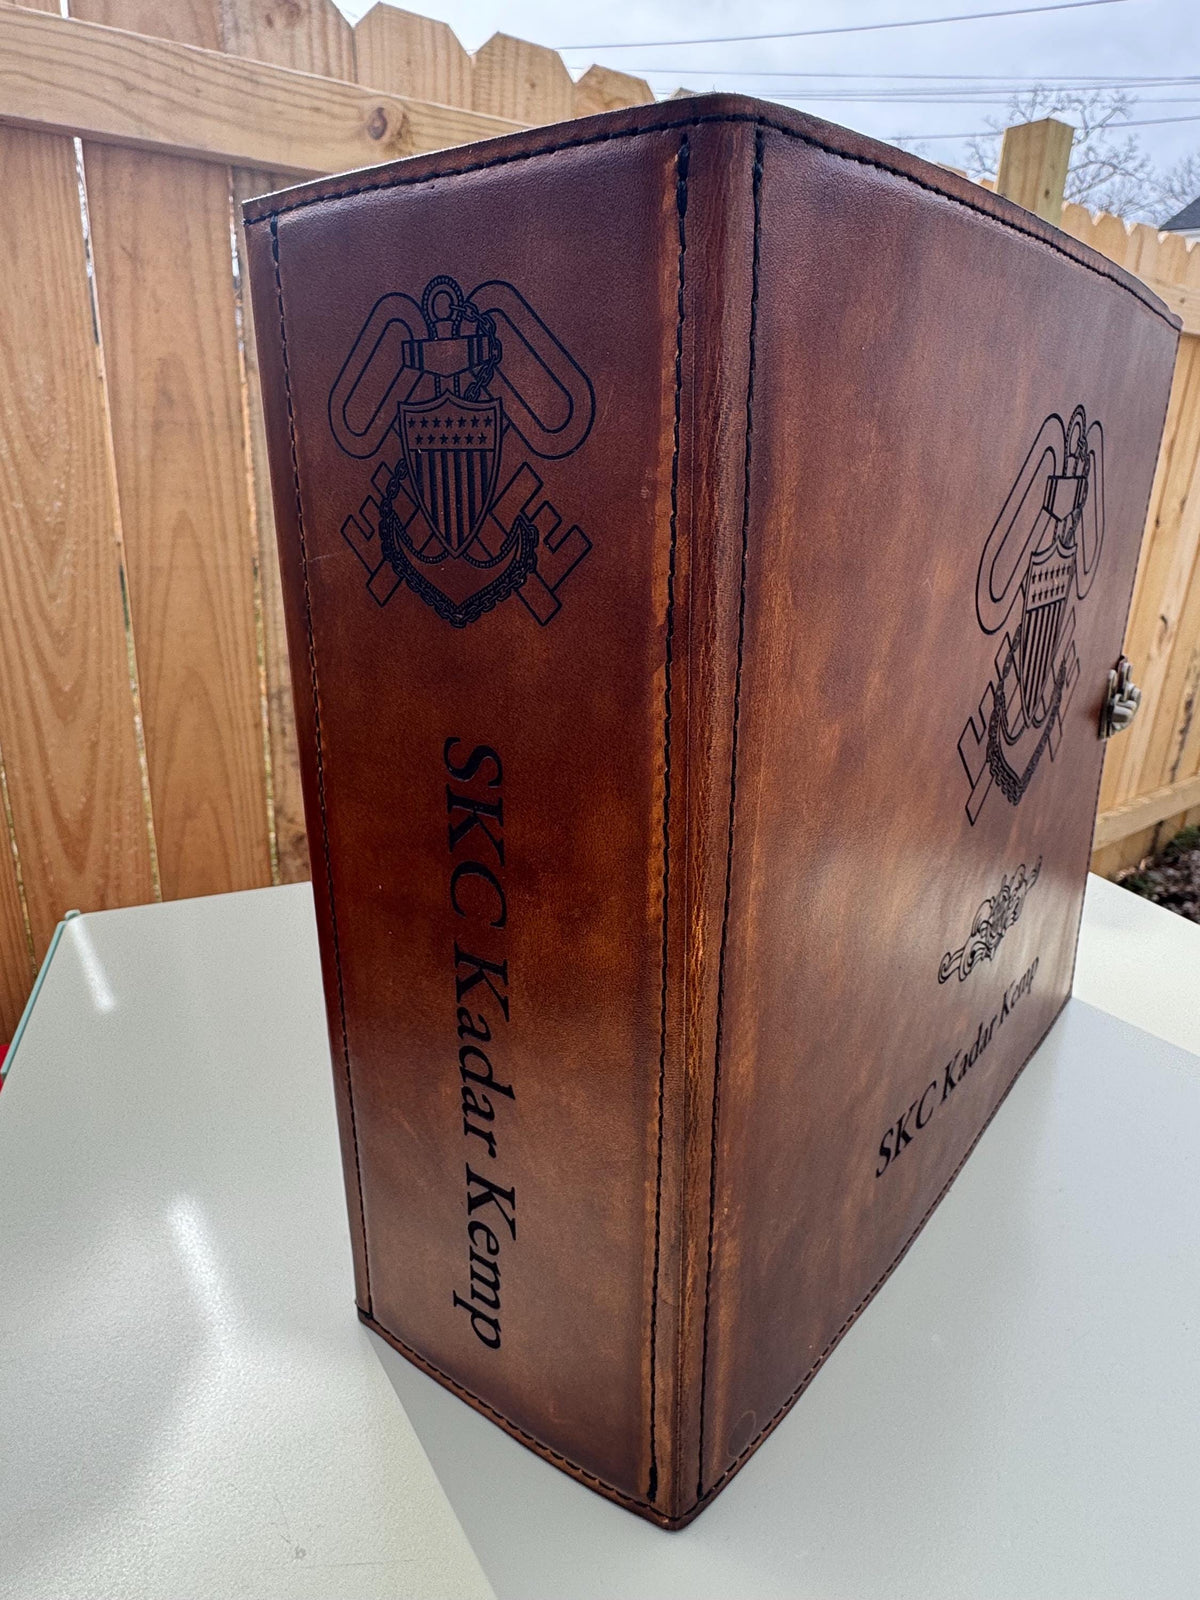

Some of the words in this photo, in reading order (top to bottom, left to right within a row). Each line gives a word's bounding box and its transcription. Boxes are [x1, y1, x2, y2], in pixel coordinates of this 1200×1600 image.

[444, 736, 506, 928] SKC
[454, 942, 516, 1159] Kadar
[875, 1080, 937, 1178] SKC
[940, 1015, 998, 1105] Kadar
[999, 956, 1040, 1027] Kemp
[453, 1162, 517, 1350] Kemp
